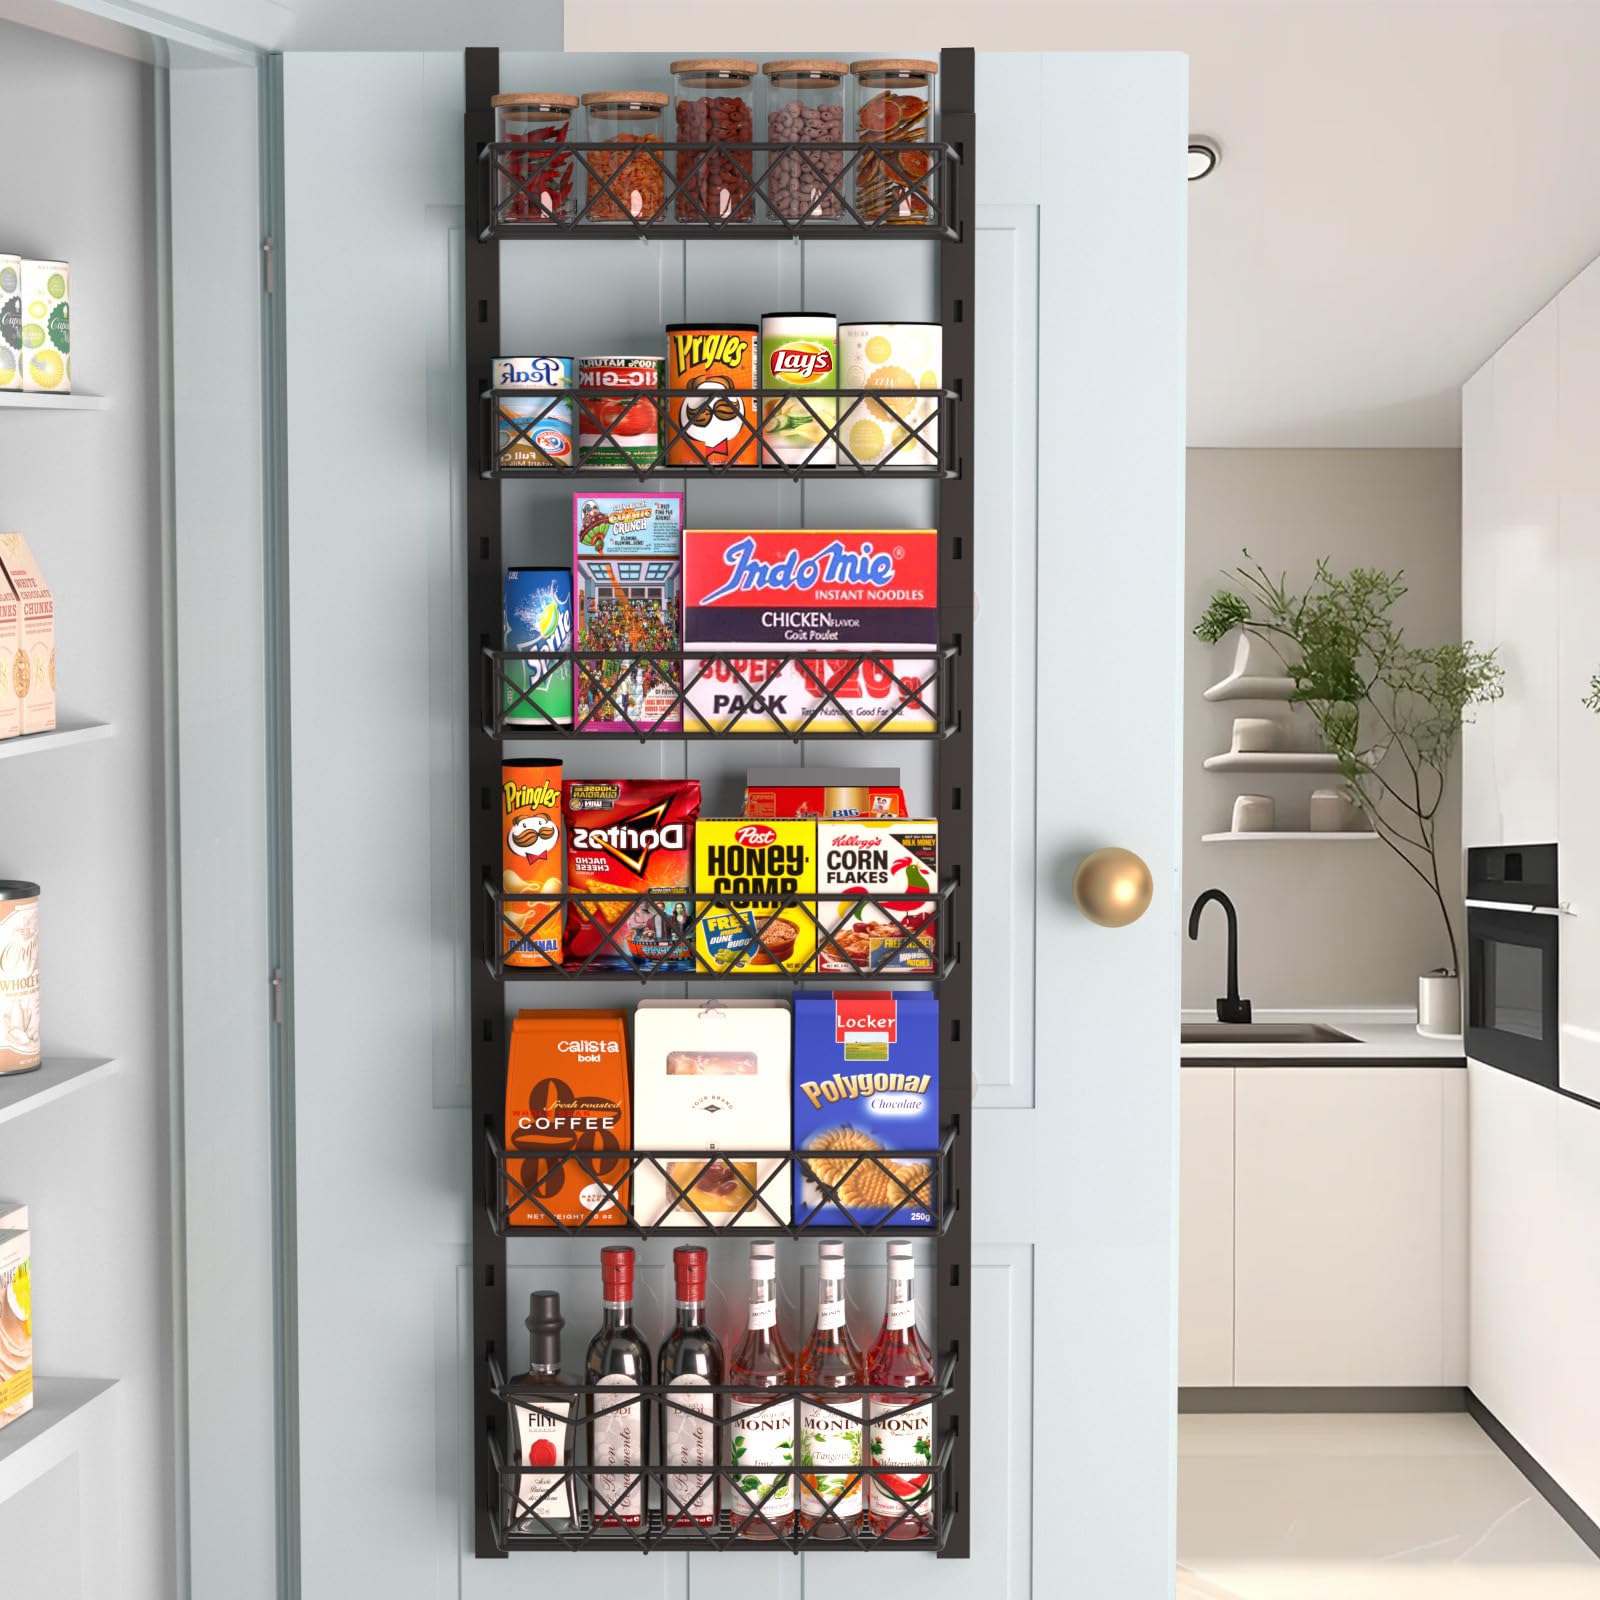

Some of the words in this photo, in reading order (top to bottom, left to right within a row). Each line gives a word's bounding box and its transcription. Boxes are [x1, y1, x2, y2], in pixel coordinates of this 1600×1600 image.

[775, 350, 829, 378] Lay's
[613, 520, 647, 536] CRUNCH
[14, 577, 38, 589] WHITE
[815, 589, 863, 601] INSTANT
[867, 589, 924, 601] NOODLES
[24, 602, 53, 616] CHUNKS
[761, 612, 831, 628] CHICKEN
[831, 618, 860, 628] FLAVOR
[809, 629, 839, 641] Poulet
[713, 694, 788, 714] PACK
[856, 707, 875, 716] Good
[504, 780, 561, 814] Pringles
[832, 808, 859, 818] BIG
[737, 827, 775, 845] Post
[831, 834, 882, 849] Kellogg's
[827, 850, 888, 871] CORN
[827, 872, 888, 884] FLAKES
[709, 935, 734, 945] DUNE
[727, 938, 754, 949] BUGG
[837, 1015, 896, 1028] Locker
[557, 1040, 619, 1053] Calista
[577, 1054, 601, 1062] bold
[800, 1073, 931, 1110] Polygonal
[543, 1100, 578, 1111] fresh
[580, 1100, 622, 1109] roasted
[871, 1098, 922, 1109] Chocolate
[518, 1117, 615, 1130] COFFEE
[910, 1212, 931, 1222] 250g
[735, 1416, 791, 1431] MONIN
[874, 1416, 929, 1431] MONIN
